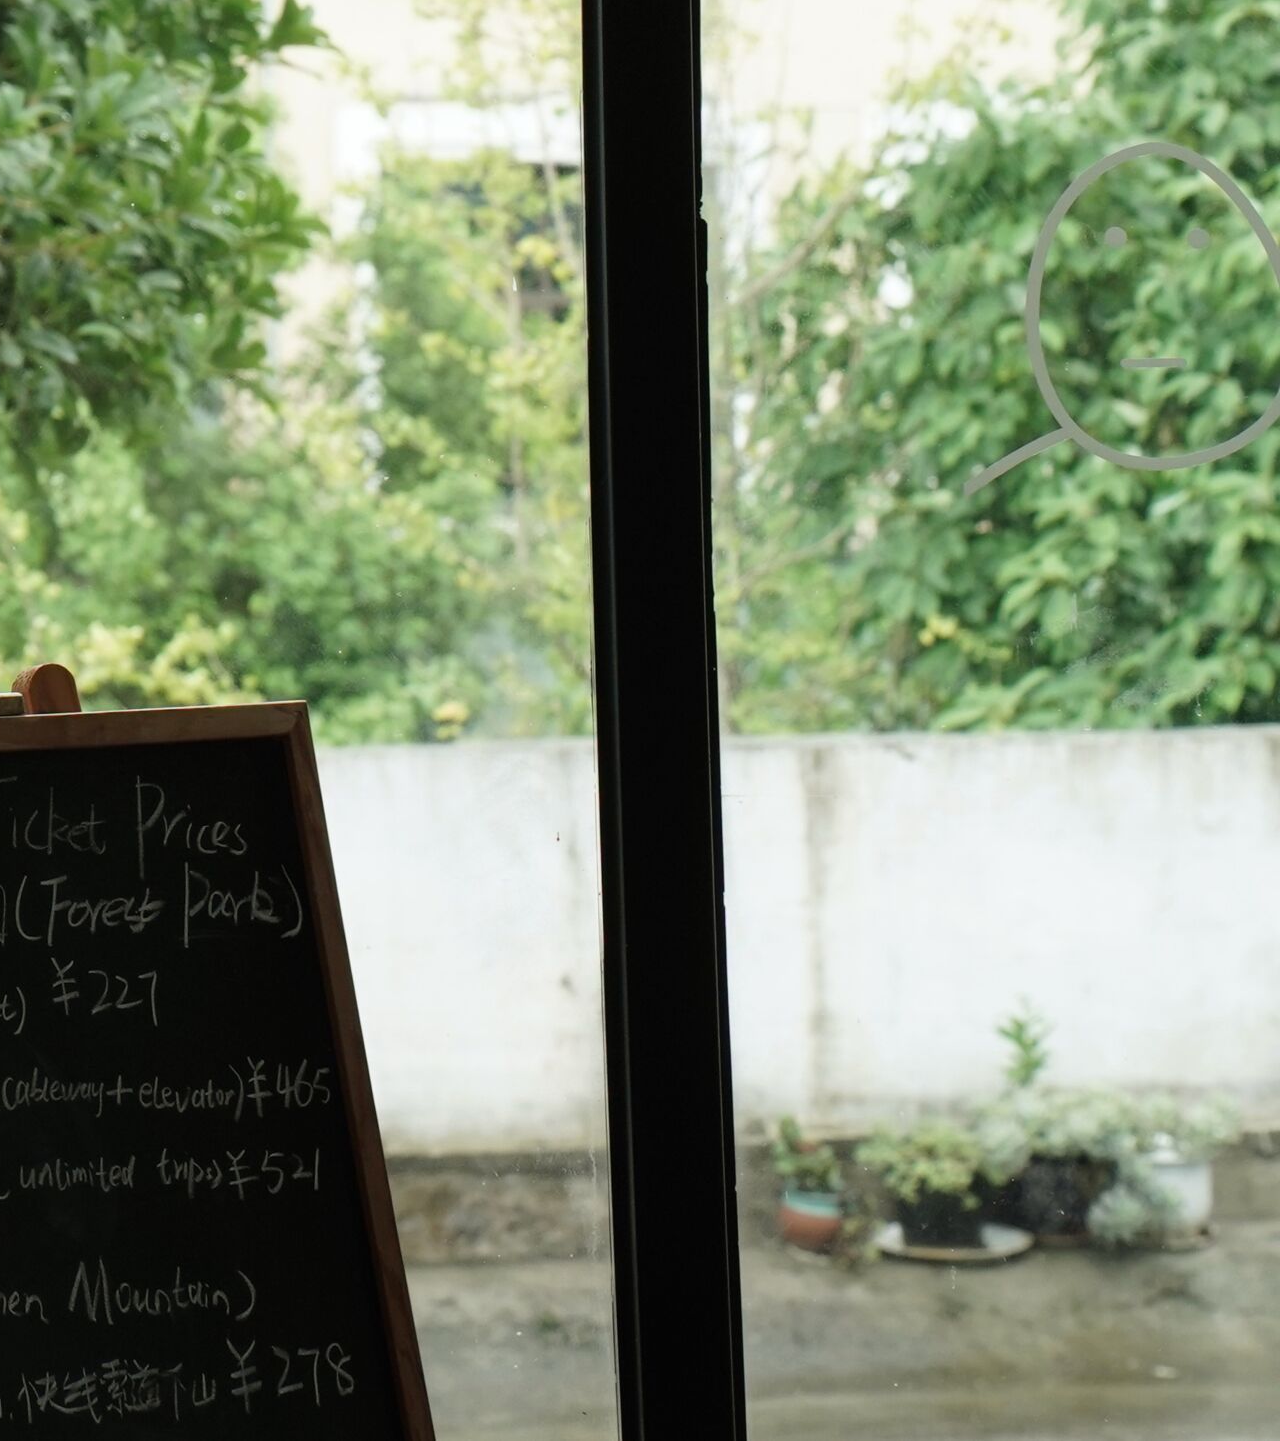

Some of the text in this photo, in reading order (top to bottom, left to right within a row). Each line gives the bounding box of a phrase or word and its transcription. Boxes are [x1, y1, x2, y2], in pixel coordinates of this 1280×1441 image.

[135, 774, 249, 880] Prices
[50, 959, 158, 1027] ¥227
[246, 1056, 331, 1119] ¥465
[225, 1337, 355, 1415] ¥278
